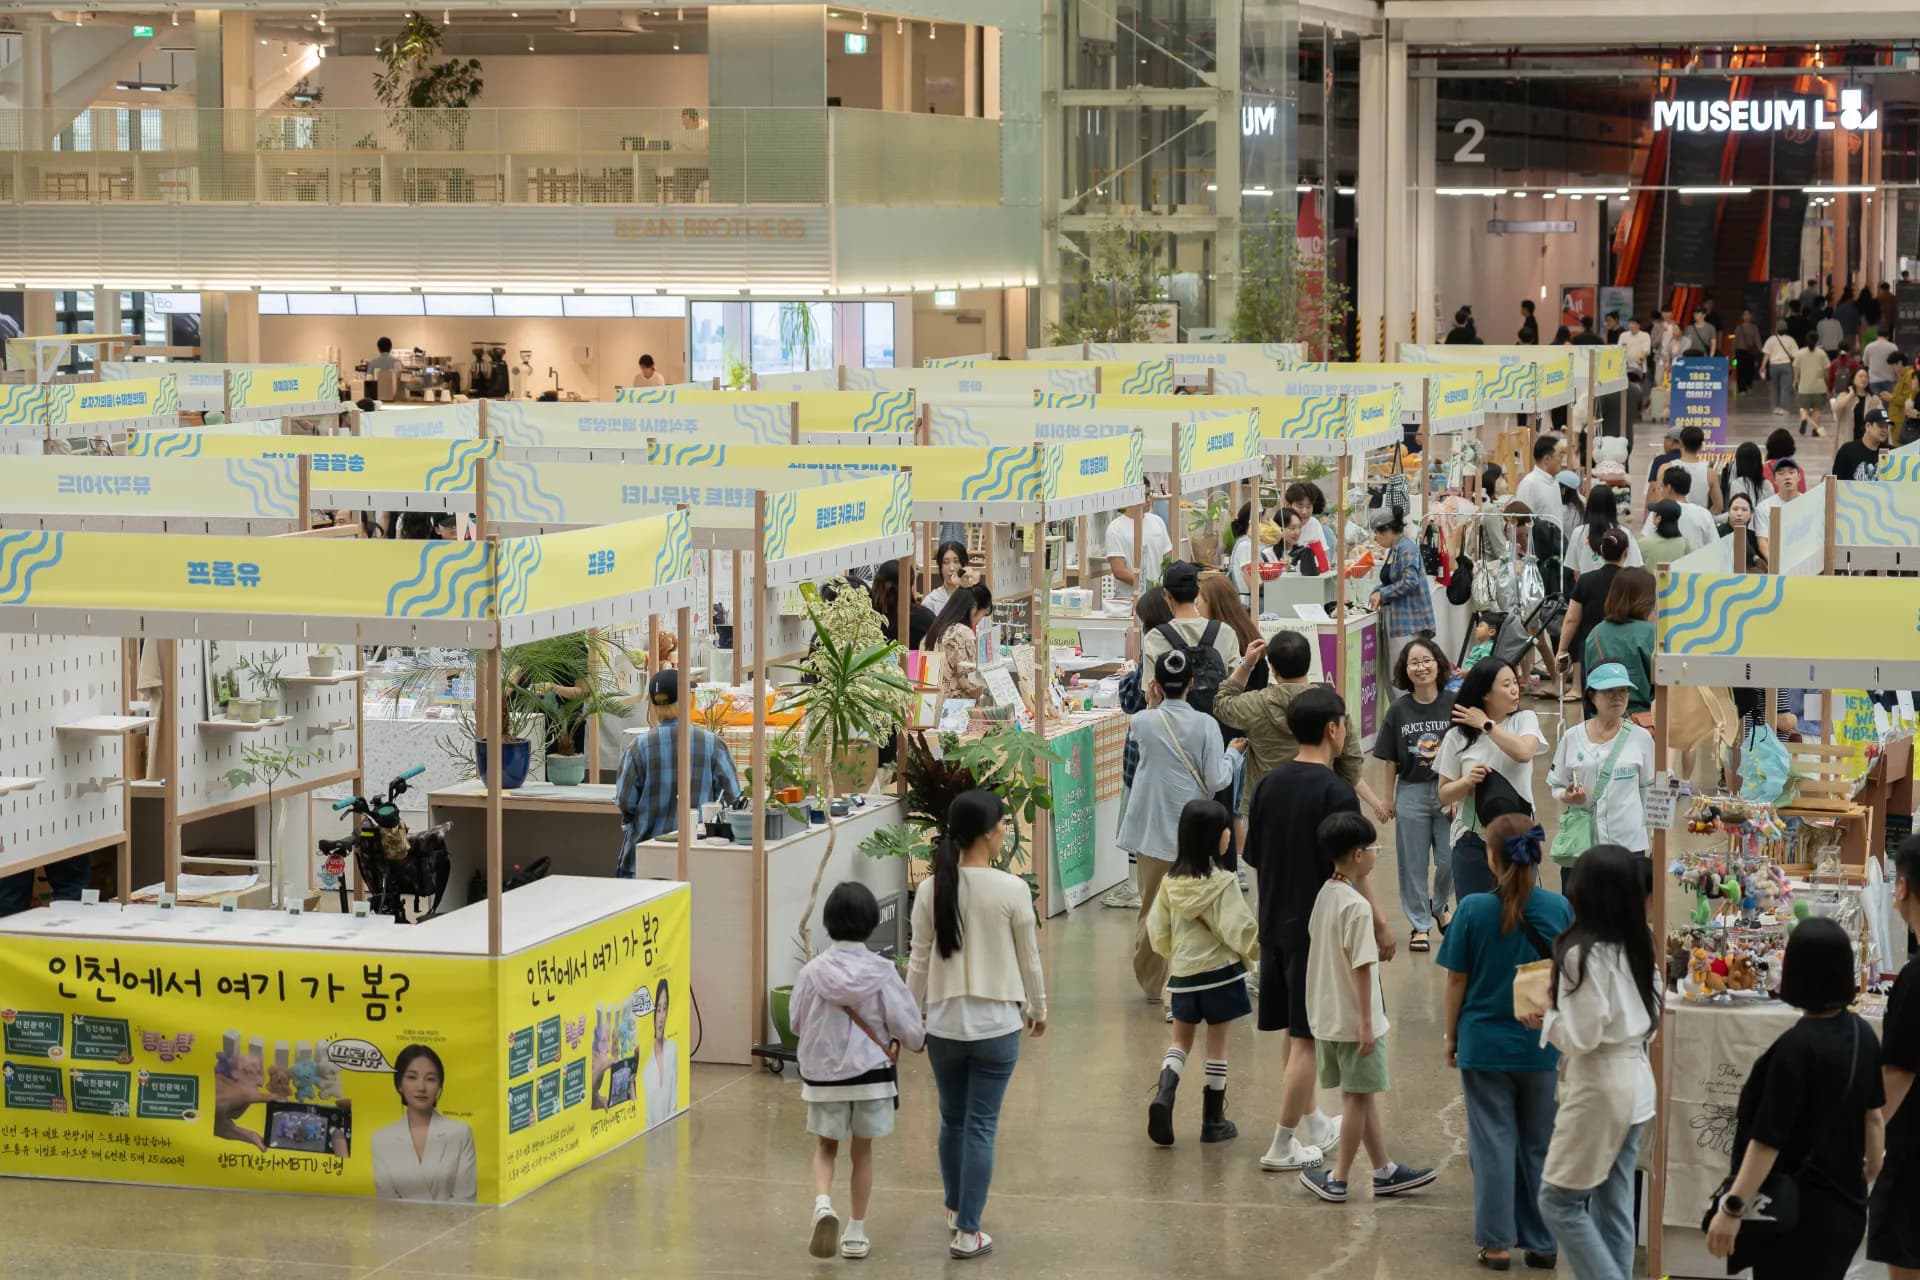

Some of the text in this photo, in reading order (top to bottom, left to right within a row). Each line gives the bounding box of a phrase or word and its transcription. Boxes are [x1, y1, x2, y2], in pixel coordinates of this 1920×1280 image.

[1653, 100, 1806, 132] MUSEUM
[1454, 118, 1486, 163] 2
[614, 217, 807, 240] BEAN BROTHERS
[816, 500, 866, 530] 플랜트 커뮤니티
[187, 560, 261, 588] 프롬유
[587, 549, 616, 577] 프롬유
[526, 911, 659, 1007] 인천에서 여기 가 봄?
[48, 954, 410, 1022] 인천에서 여기 가 봄?
[331, 1043, 383, 1070] 프롬유
[322, 1157, 344, 1177] 인형
